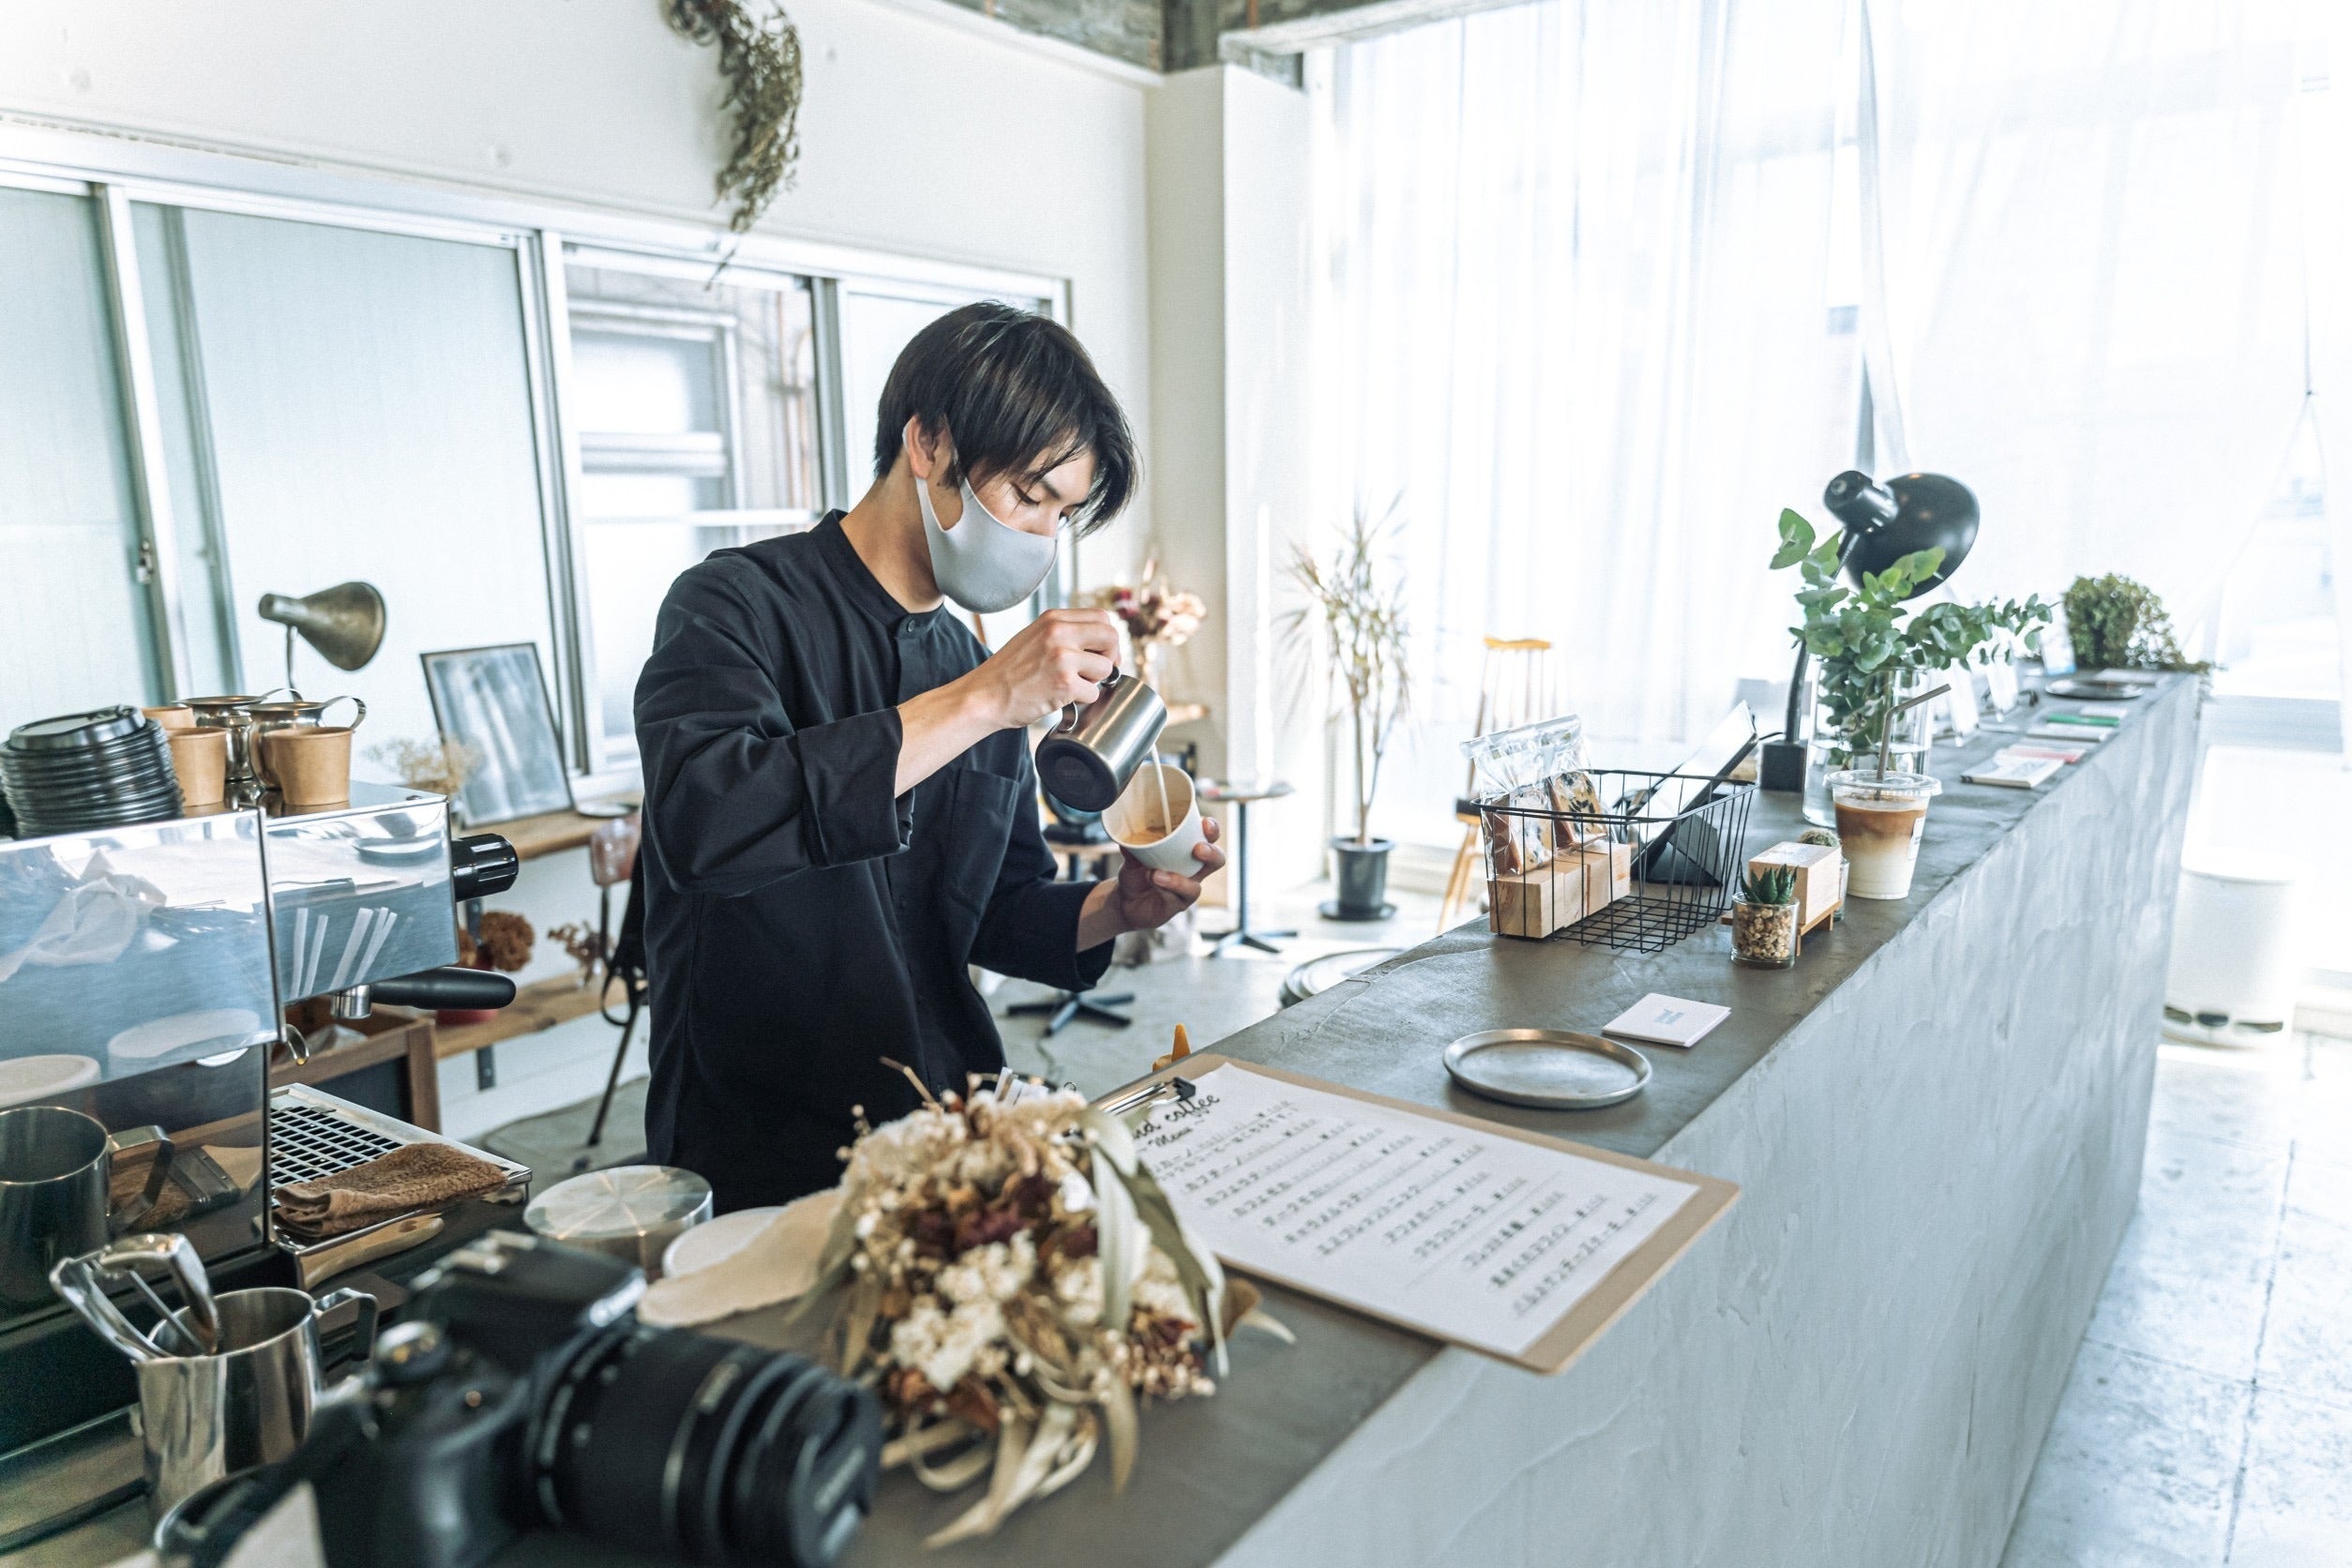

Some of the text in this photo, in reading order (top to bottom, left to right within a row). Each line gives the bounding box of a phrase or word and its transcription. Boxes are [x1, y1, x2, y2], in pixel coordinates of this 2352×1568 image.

[1133, 1094, 1220, 1139] nd coffee
[1148, 1126, 1193, 1146] Menu
